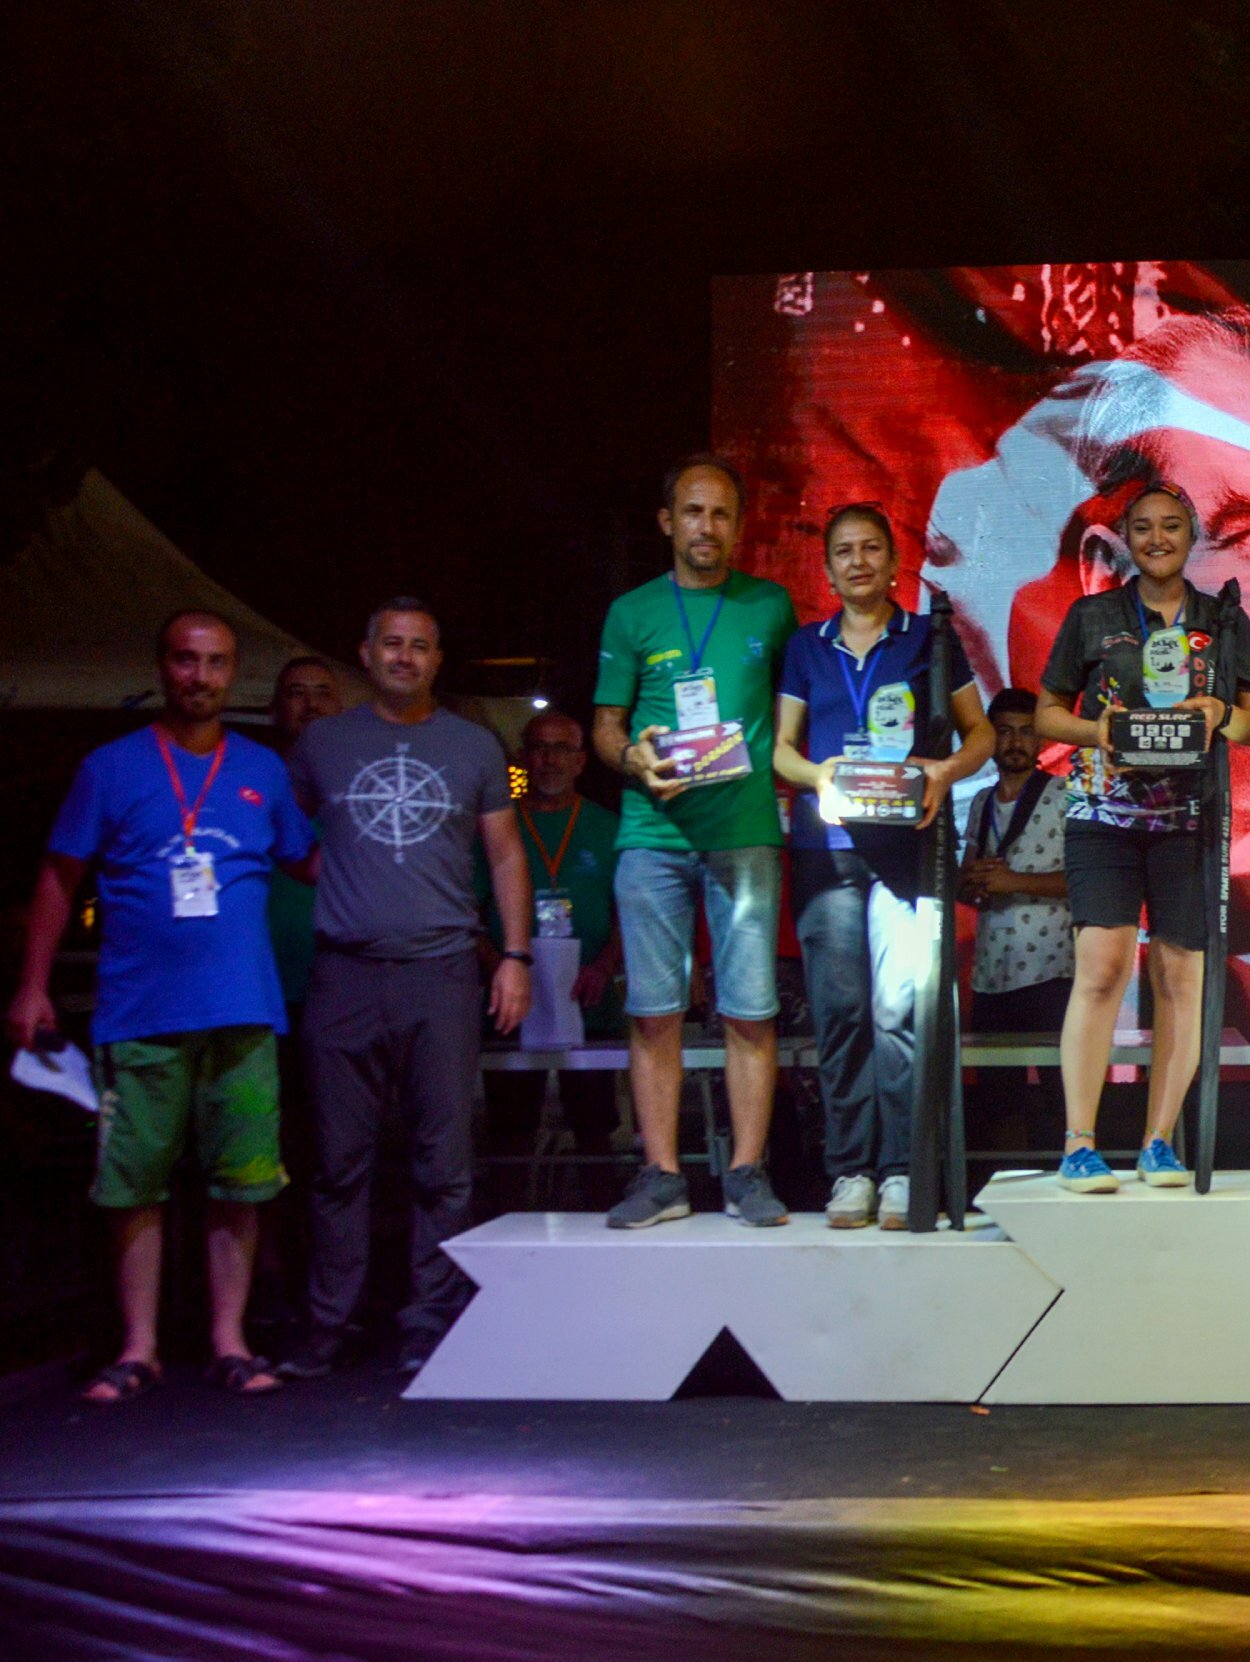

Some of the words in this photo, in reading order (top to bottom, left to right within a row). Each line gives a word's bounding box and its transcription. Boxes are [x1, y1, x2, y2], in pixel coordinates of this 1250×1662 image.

[1129, 713, 1156, 721] RED
[1157, 713, 1192, 721] SURF
[1221, 839, 1230, 864] SURF
[1220, 866, 1230, 901] SPARTA
